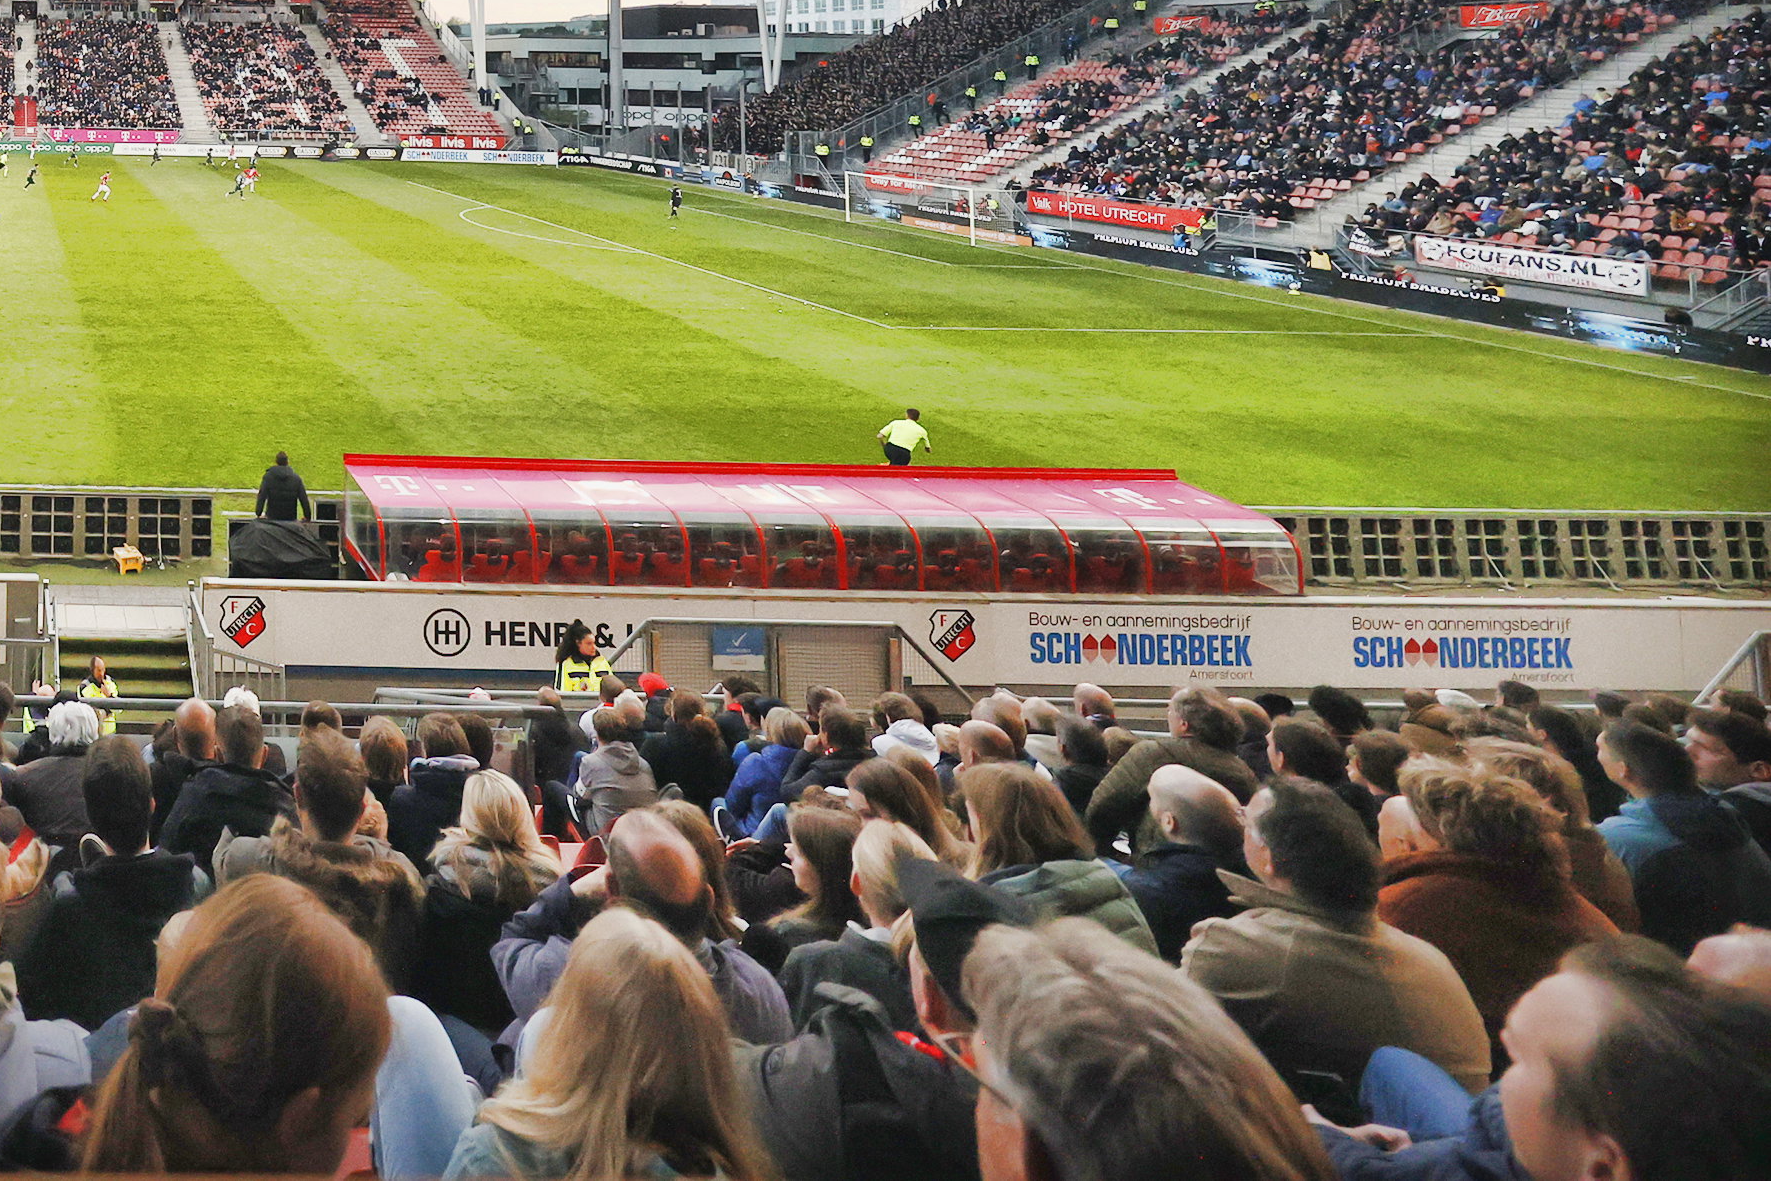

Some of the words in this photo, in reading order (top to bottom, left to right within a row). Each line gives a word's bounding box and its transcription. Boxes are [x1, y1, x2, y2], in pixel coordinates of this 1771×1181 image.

[409, 136, 433, 148] livis
[441, 136, 465, 148] livis
[473, 137, 497, 149] livis
[84, 144, 111, 154] oppo
[559, 155, 589, 164] STIGA
[637, 164, 656, 174] STIGA
[715, 178, 741, 188] NAPOLEON
[871, 176, 889, 188] Only
[1032, 196, 1052, 210] Valk
[1059, 201, 1099, 218] HOTEL
[1103, 206, 1166, 225] UTRECHT
[1447, 245, 1605, 278] FCUFANS.NL
[231, 601, 238, 613] F
[226, 599, 264, 639] UTRECHT
[940, 615, 947, 626] F
[1029, 612, 1078, 627] Bouw-
[1082, 615, 1102, 627] en
[1106, 614, 1252, 632] aannemingsbedrijf
[245, 622, 256, 636] C
[1352, 616, 1400, 631] Bouw-
[1405, 619, 1424, 631] en
[1428, 618, 1572, 636] aannemingsbedrijf
[595, 623, 617, 648] &
[935, 615, 972, 651] UTRECHT
[955, 636, 965, 649] C
[1189, 670, 1253, 680] Amersfoort
[1511, 672, 1574, 682] Amersfoort
